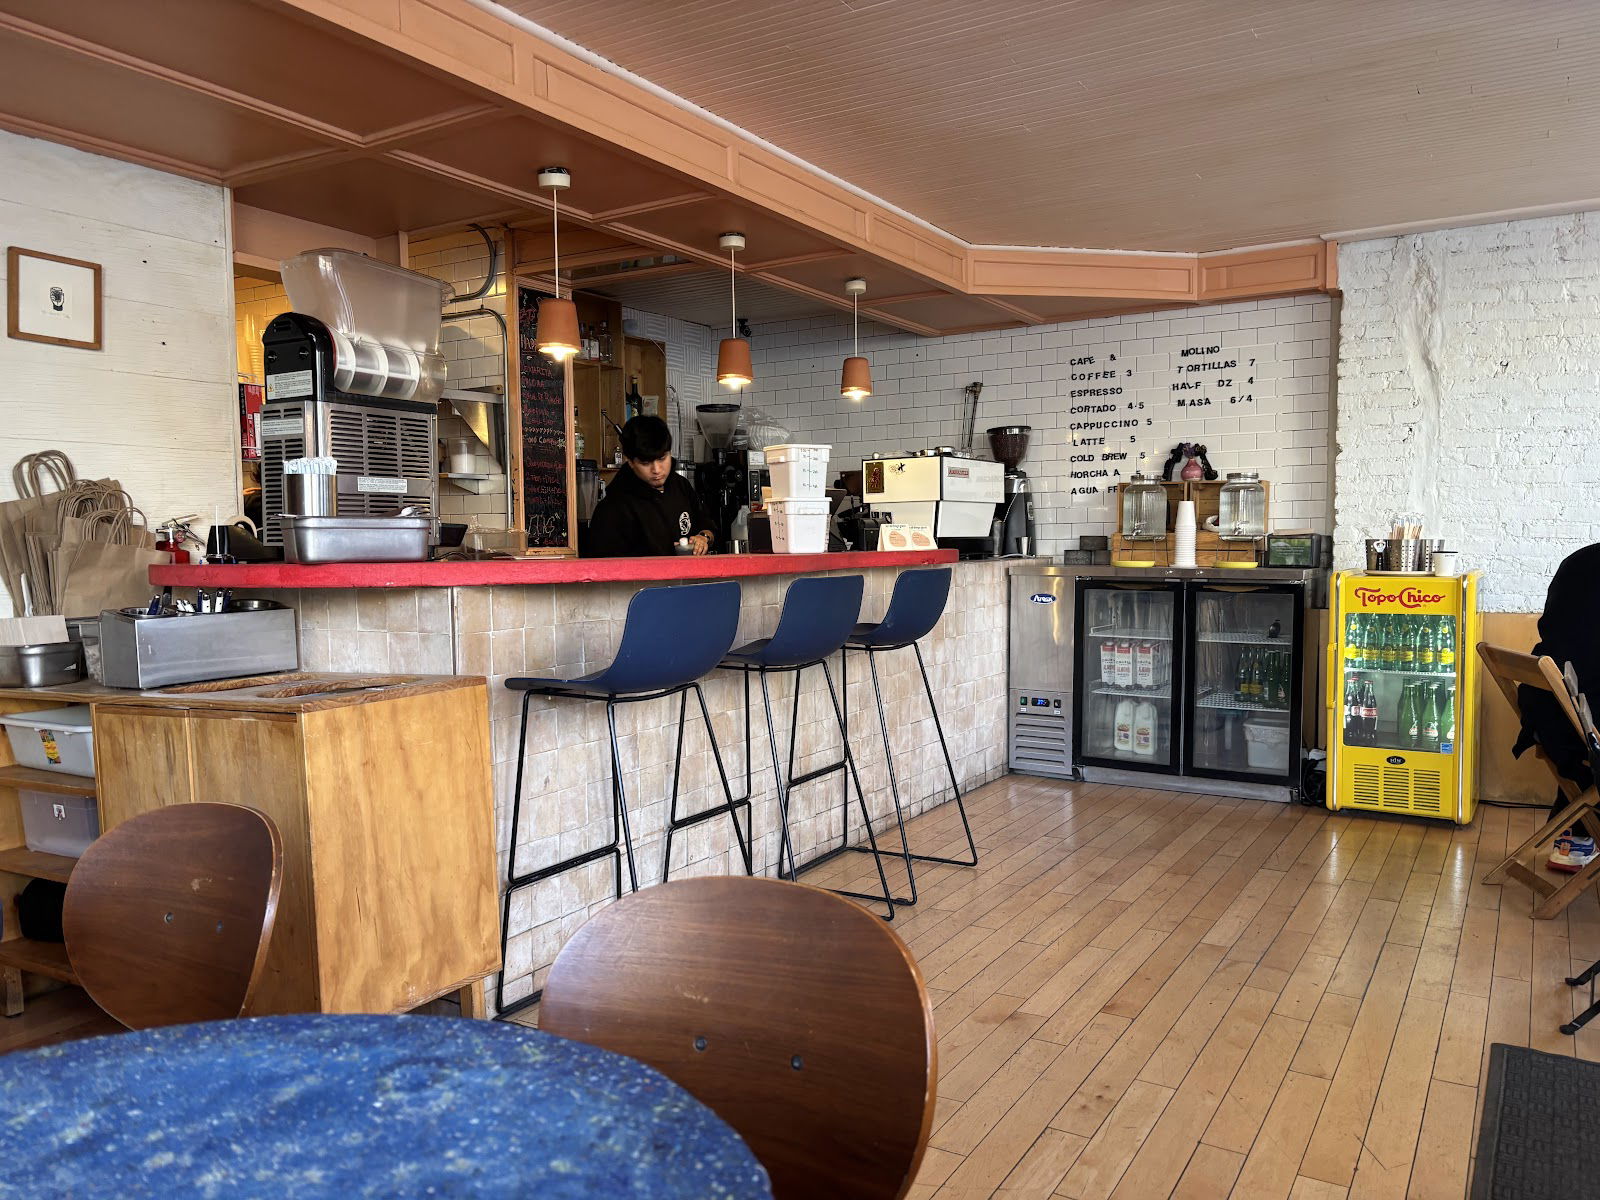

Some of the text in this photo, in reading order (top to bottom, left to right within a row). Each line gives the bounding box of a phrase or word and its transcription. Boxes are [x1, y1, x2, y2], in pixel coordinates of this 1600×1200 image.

[1181, 345, 1220, 357] MOLINO
[1070, 356, 1096, 366] CAFE
[1177, 358, 1256, 374] TORTILLAS 7
[1071, 369, 1133, 381] COFFEE 3
[1172, 376, 1254, 392] HALF DZ 4
[1070, 387, 1123, 398] ESPRESSO
[1177, 397, 1212, 408] MASA
[1070, 404, 1117, 415] CORTADO
[1070, 418, 1153, 431] CAPPUCCINO 5
[1073, 435, 1136, 447] LATTE 5
[1070, 451, 1146, 464] COLD BREW 5
[1070, 486, 1099, 496] AGUA
[1355, 587, 1446, 609] Topo Chico
